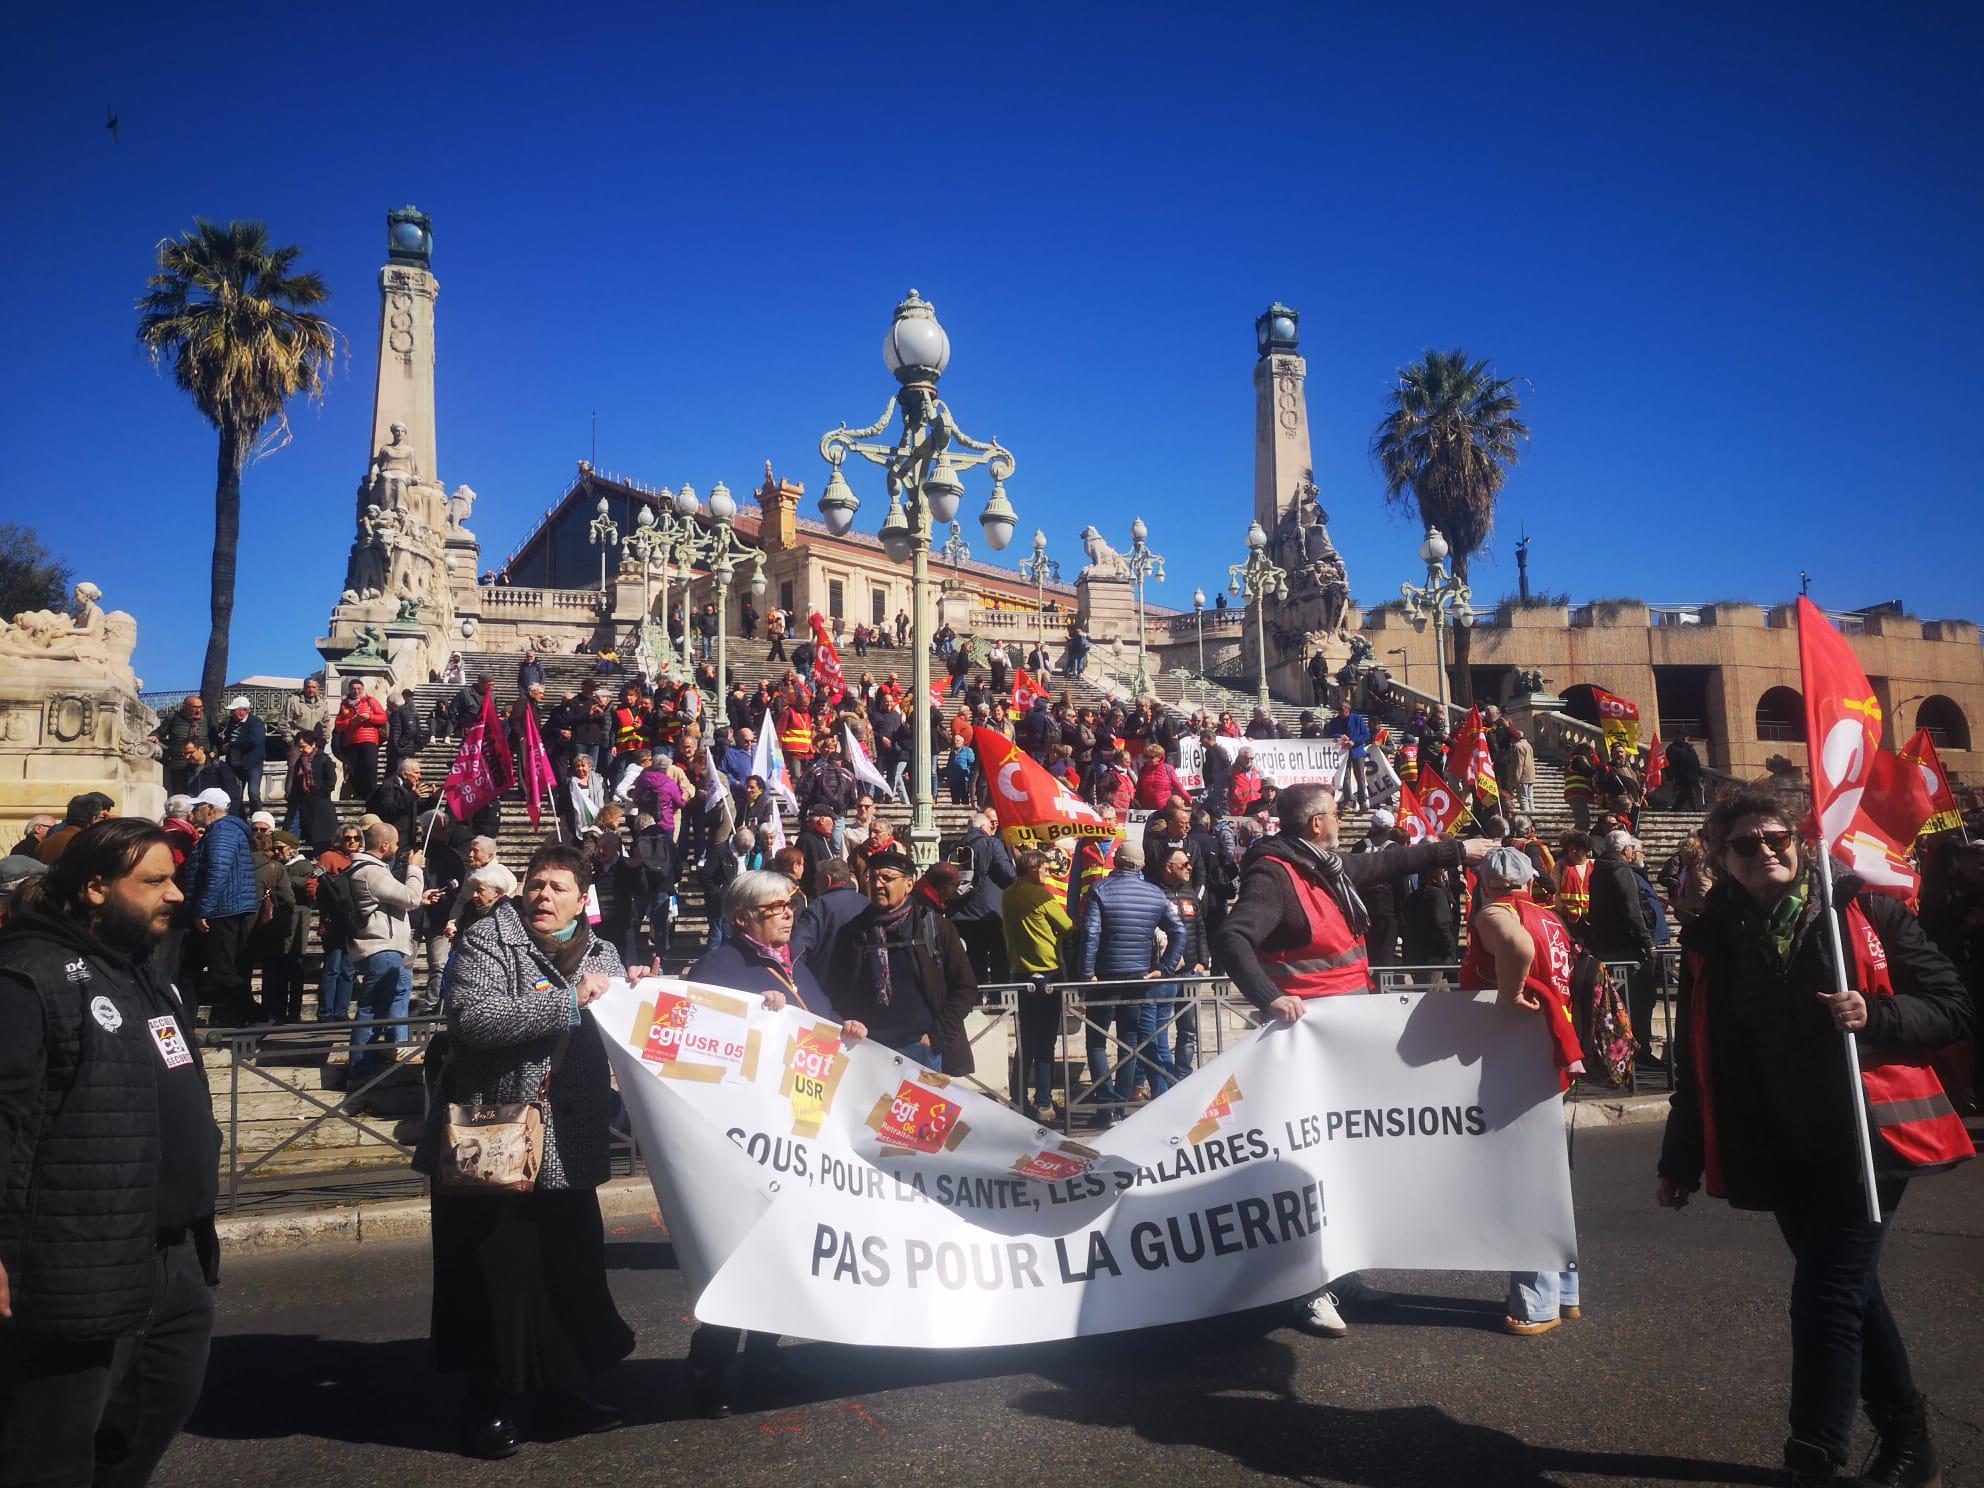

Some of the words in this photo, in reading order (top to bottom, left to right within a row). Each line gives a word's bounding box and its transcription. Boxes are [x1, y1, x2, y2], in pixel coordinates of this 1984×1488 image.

[1288, 751, 1304, 770] en
[1307, 745, 1340, 770] Lutte
[1017, 826, 1043, 842] UL
[685, 1033, 720, 1053] USR
[724, 1042, 745, 1059] 05
[791, 1049, 835, 1078] cgt
[795, 1075, 824, 1102] USR
[891, 1098, 920, 1123] cgt
[902, 1122, 917, 1134] 06
[820, 1152, 886, 1200] POUR
[894, 1169, 930, 1204] LA
[1048, 1174, 1106, 1205] LES
[1113, 1128, 1281, 1189] SALAIRES,
[1285, 1114, 1322, 1152] LES
[1326, 1105, 1487, 1141] PENSIONS
[811, 1222, 891, 1288] PAS
[905, 1239, 1044, 1290] POUR
[1054, 1230, 1123, 1285] LA
